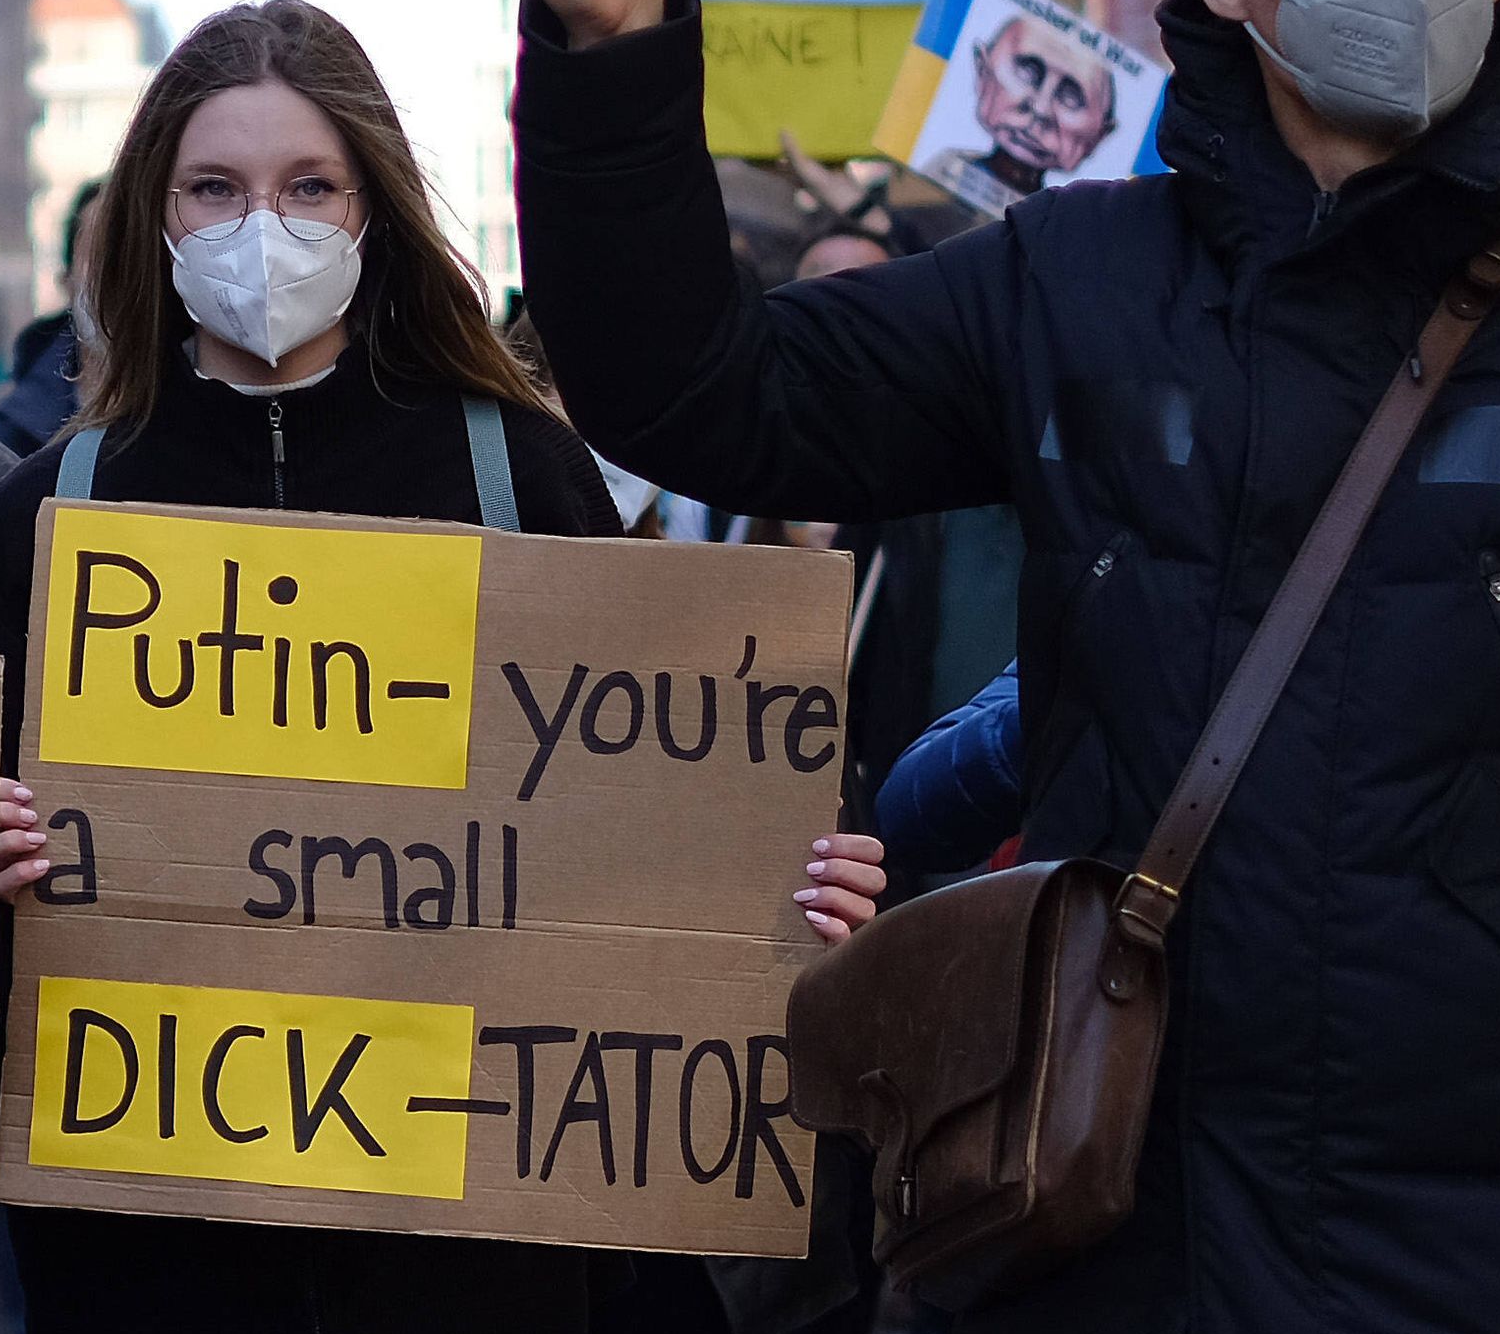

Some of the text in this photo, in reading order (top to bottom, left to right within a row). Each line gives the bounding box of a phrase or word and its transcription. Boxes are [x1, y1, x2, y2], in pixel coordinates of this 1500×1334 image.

[500, 633, 840, 802] you're
[33, 808, 519, 931] a small
